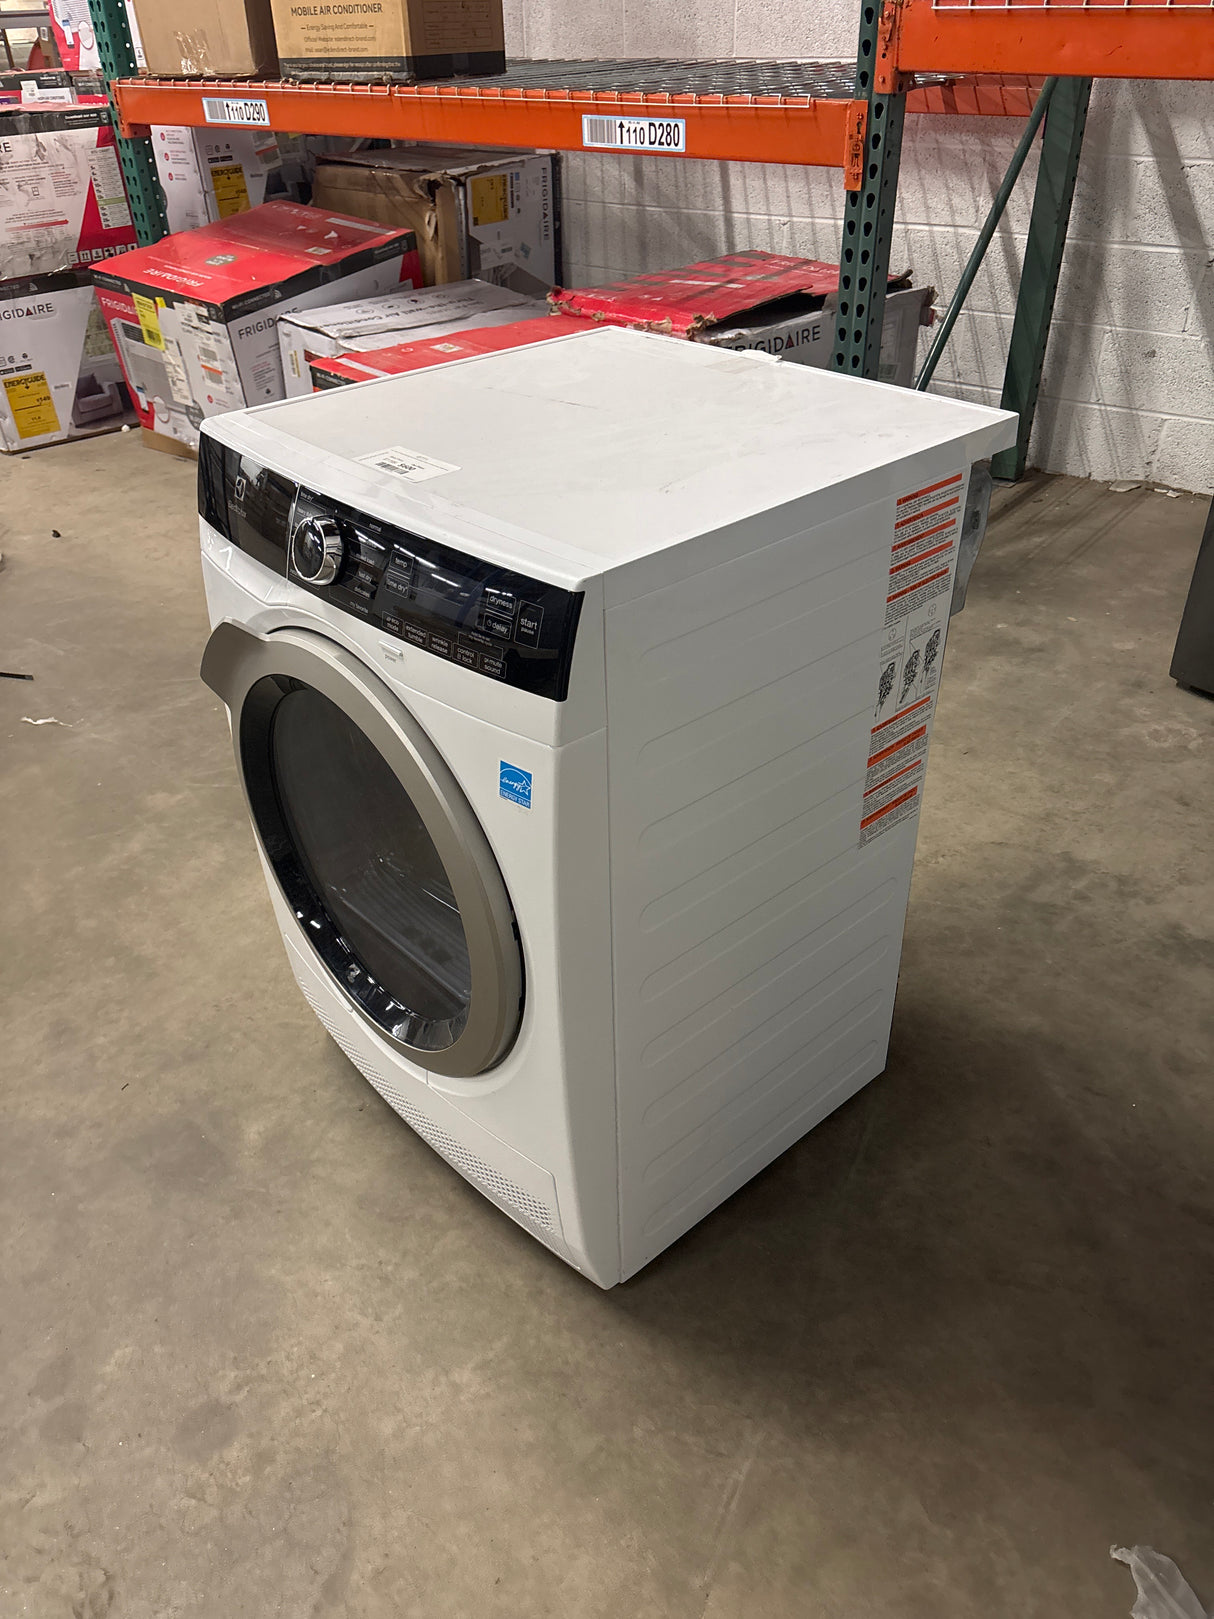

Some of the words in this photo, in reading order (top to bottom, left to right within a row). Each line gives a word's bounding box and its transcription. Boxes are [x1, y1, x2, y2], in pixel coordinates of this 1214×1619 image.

[291, 6, 318, 16] MOBILE
[319, 5, 332, 15] AIR
[332, 3, 383, 15] CONDITIONER
[231, 105, 245, 121] 110
[244, 102, 266, 122] D290
[625, 126, 645, 145] 110
[648, 122, 681, 147] D280
[541, 167, 550, 241] FRIGIDAIRE
[395, 557, 408, 568] temp
[489, 595, 513, 609] dryness
[491, 622, 509, 635] delay
[520, 618, 538, 630] start
[457, 647, 475, 658] control
[461, 655, 473, 664] lock
[484, 664, 501, 675] sound
[517, 797, 530, 808] STAR
